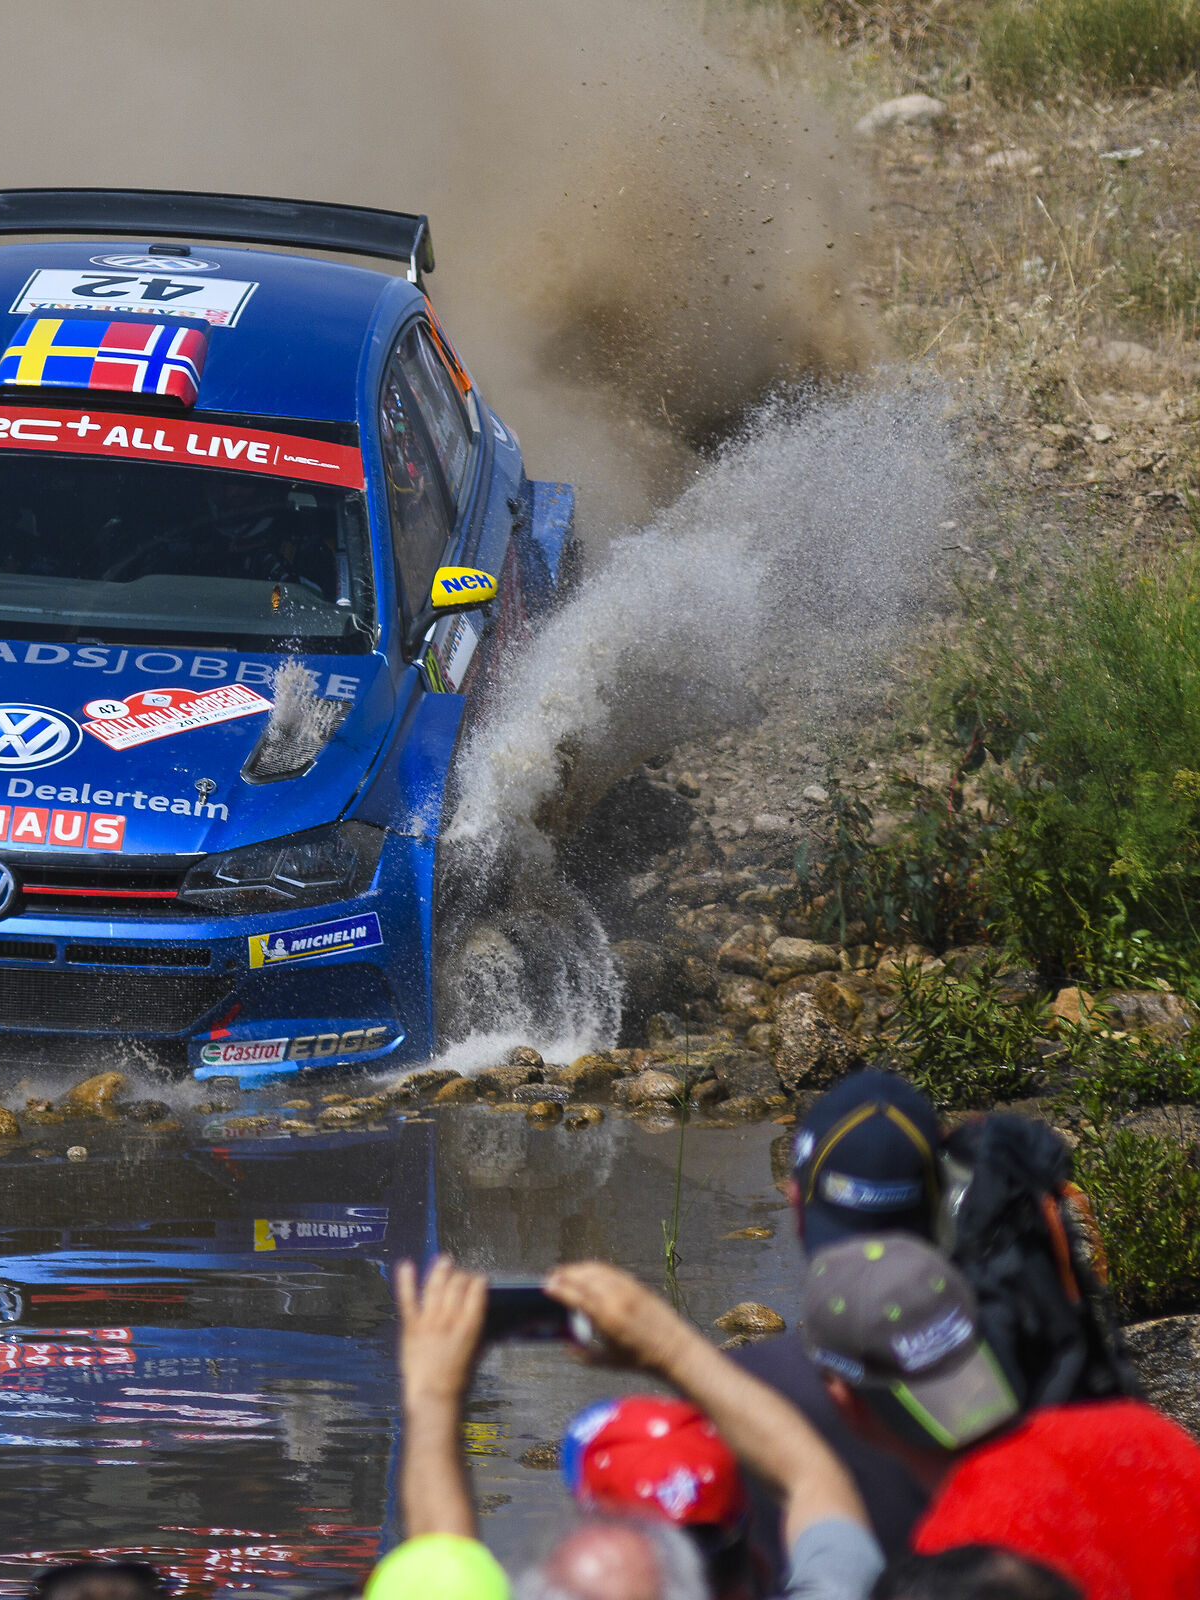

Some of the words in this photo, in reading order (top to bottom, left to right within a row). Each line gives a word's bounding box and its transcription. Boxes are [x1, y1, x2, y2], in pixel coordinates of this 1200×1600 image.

[71, 275, 205, 302] 42
[102, 425, 175, 452] ALL
[186, 433, 271, 464] LIVE
[93, 715, 141, 741] RALLY
[136, 706, 189, 729] ITALIA
[178, 685, 257, 719] SARDEGNA
[99, 703, 121, 715] 42
[175, 715, 210, 729] 2019
[7, 777, 229, 821] Dealerteam
[290, 926, 368, 952] MICHELIN
[222, 1041, 283, 1062] Castrol
[287, 1026, 388, 1060] EDGE
